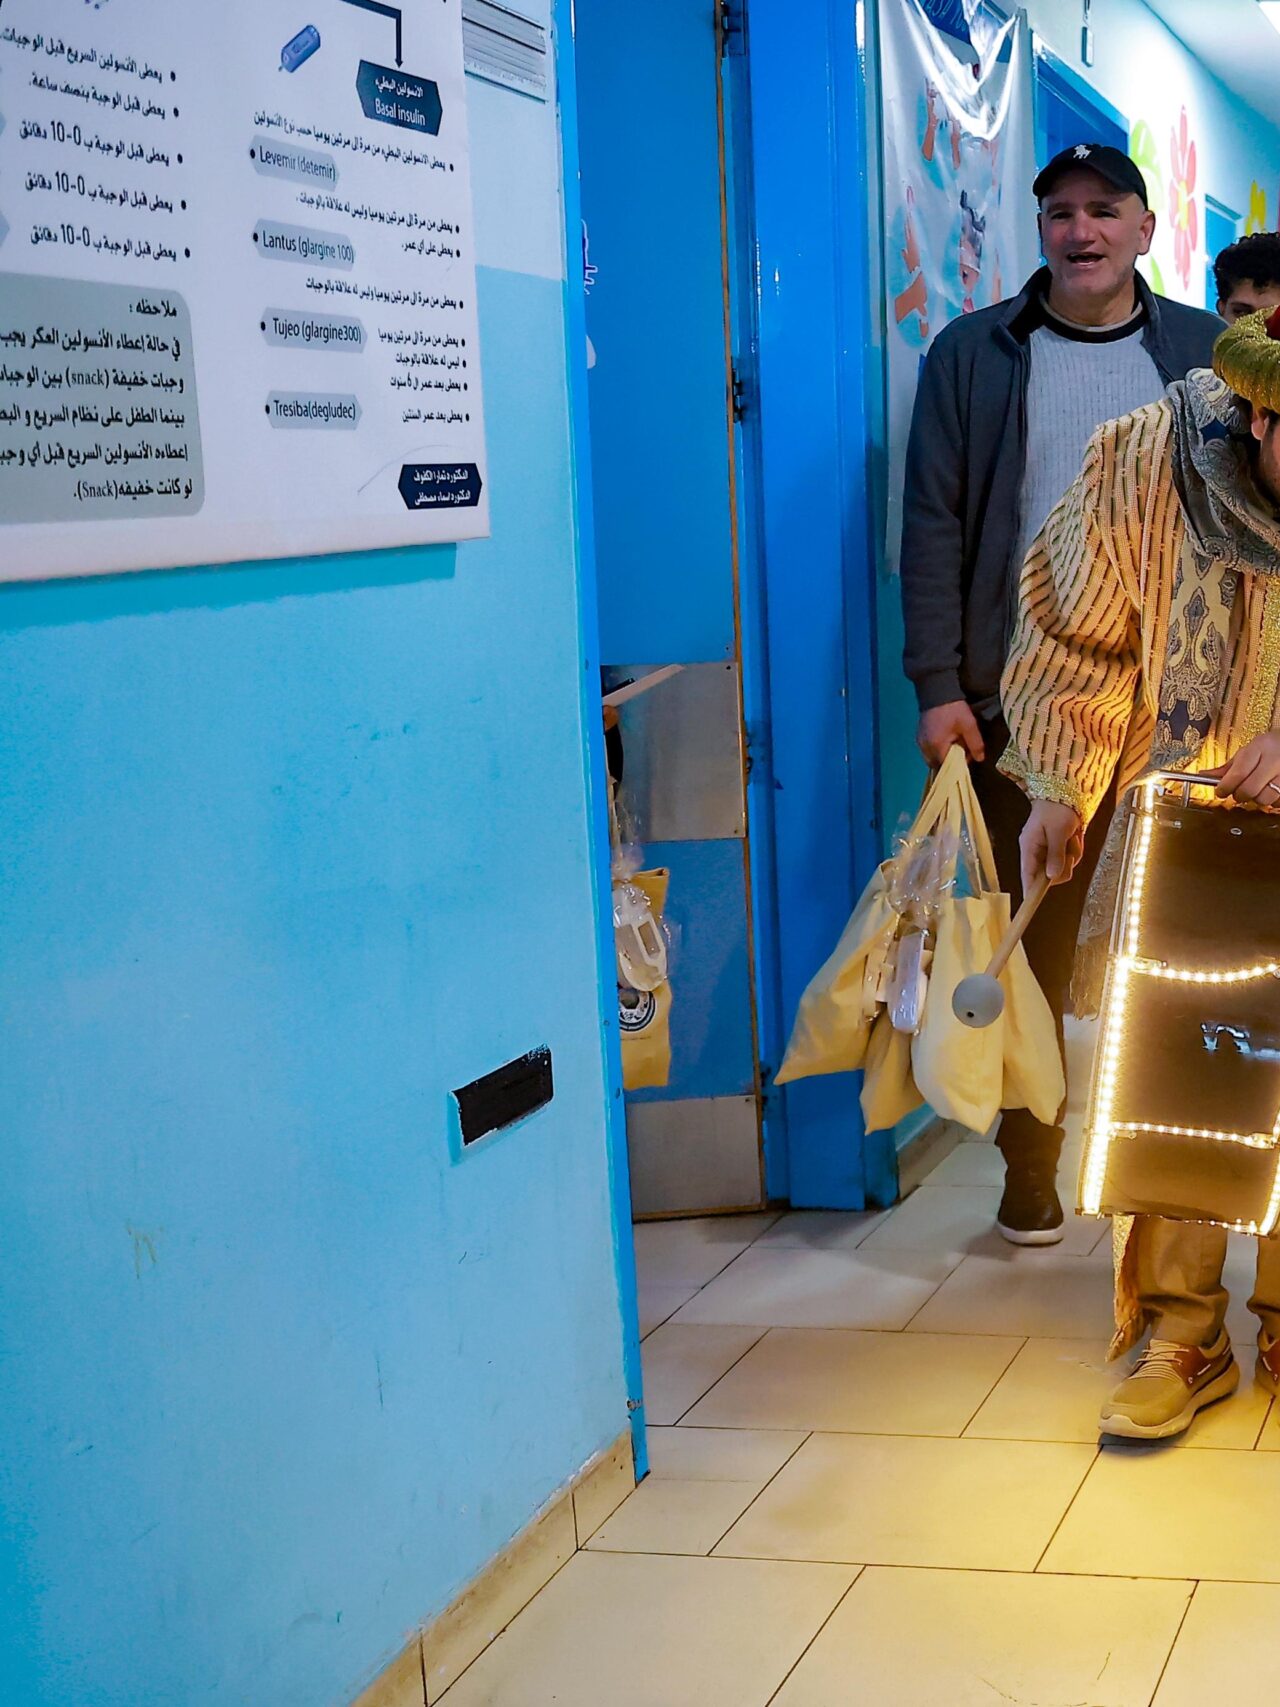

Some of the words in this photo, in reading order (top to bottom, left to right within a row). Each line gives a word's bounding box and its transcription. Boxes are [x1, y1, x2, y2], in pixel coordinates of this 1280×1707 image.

[46, 38, 64, 57] قبل
[67, 47, 97, 64] السريع
[139, 62, 162, 83] يعطى
[60, 80, 89, 103] بنصف
[92, 84, 122, 109] الوجبة
[124, 95, 140, 113] قبل
[142, 100, 165, 120] يعطى
[375, 98, 396, 118] Basal
[398, 105, 425, 126] insulin
[20, 120, 47, 140] دقائق
[95, 134, 125, 158] الوجبة
[127, 143, 143, 161] قبل
[146, 148, 169, 166] يعطى
[259, 145, 296, 170] Levemir
[298, 154, 336, 182] (detemir)
[25, 172, 52, 191] دقائق
[99, 184, 128, 206] الوجبة
[130, 191, 147, 209] قبل
[149, 194, 173, 213] يعطى
[30, 225, 58, 244] دقائق
[103, 235, 132, 257] الوجبة
[134, 241, 151, 258] قبل
[152, 244, 177, 262] يعطى
[263, 230, 296, 251] Lantus
[299, 236, 335, 260] (glargine
[337, 244, 354, 264] 100)
[426, 242, 436, 255] على
[306, 277, 334, 293] بالوجبات
[31, 326, 59, 349] العكر
[273, 318, 299, 339] Tujeo
[302, 321, 362, 344] (glargine300)
[147, 333, 169, 351] حالة
[171, 337, 181, 361] في
[396, 353, 420, 367] بالوجبات
[0, 364, 38, 388] الوجبا
[42, 370, 62, 389] بين
[65, 366, 109, 389] (snack)
[112, 368, 148, 391] خفيفة
[152, 372, 184, 393] وجبات
[34, 403, 69, 430] السريع
[72, 405, 99, 428] نظام
[101, 406, 123, 428] على
[125, 406, 157, 427] الطفل
[159, 408, 185, 428] بينما
[0, 449, 25, 466] وجب
[28, 441, 41, 467] أي
[43, 442, 65, 465] قبل
[68, 443, 102, 468] السريع
[157, 478, 180, 495] كانت
[184, 478, 192, 499] لو
